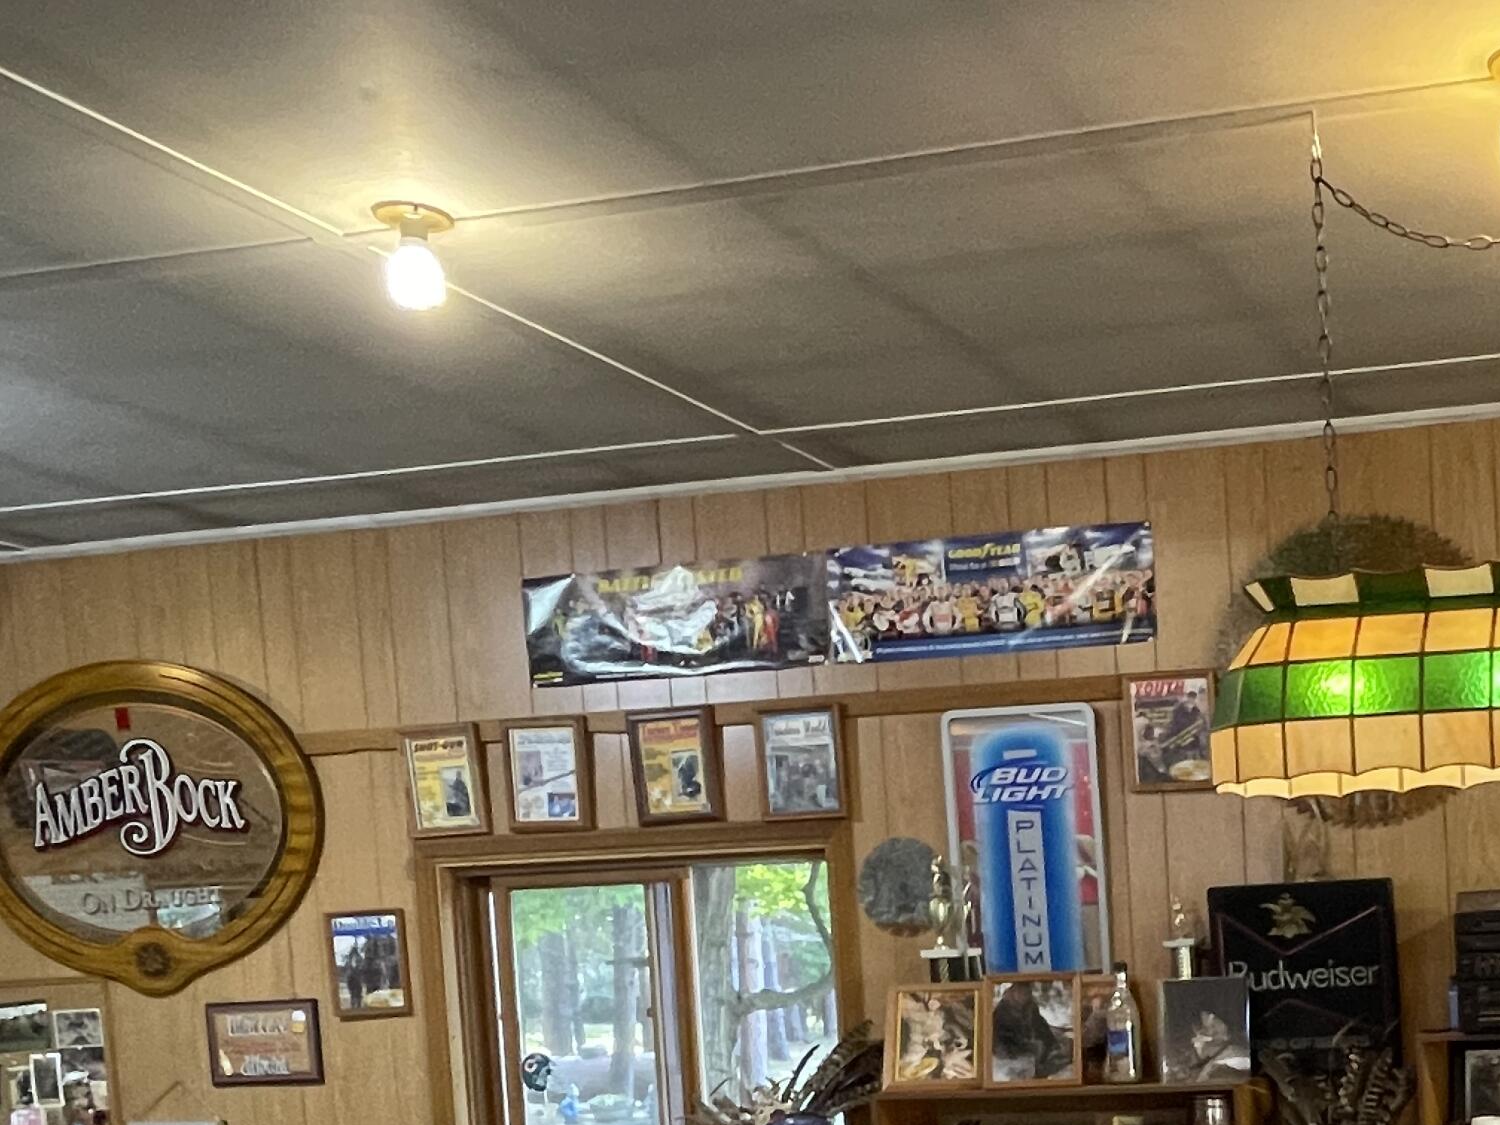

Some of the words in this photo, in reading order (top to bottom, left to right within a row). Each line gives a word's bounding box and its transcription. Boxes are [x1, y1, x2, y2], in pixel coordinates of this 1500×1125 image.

[948, 543, 1021, 560] GOODYEAR
[989, 766, 1068, 786] BUD
[34, 765, 148, 847] AMBER
[119, 738, 245, 855] BOCK
[974, 785, 1077, 804] LIGHT
[82, 892, 116, 915] ON
[1014, 820, 1045, 966] PLATINUM
